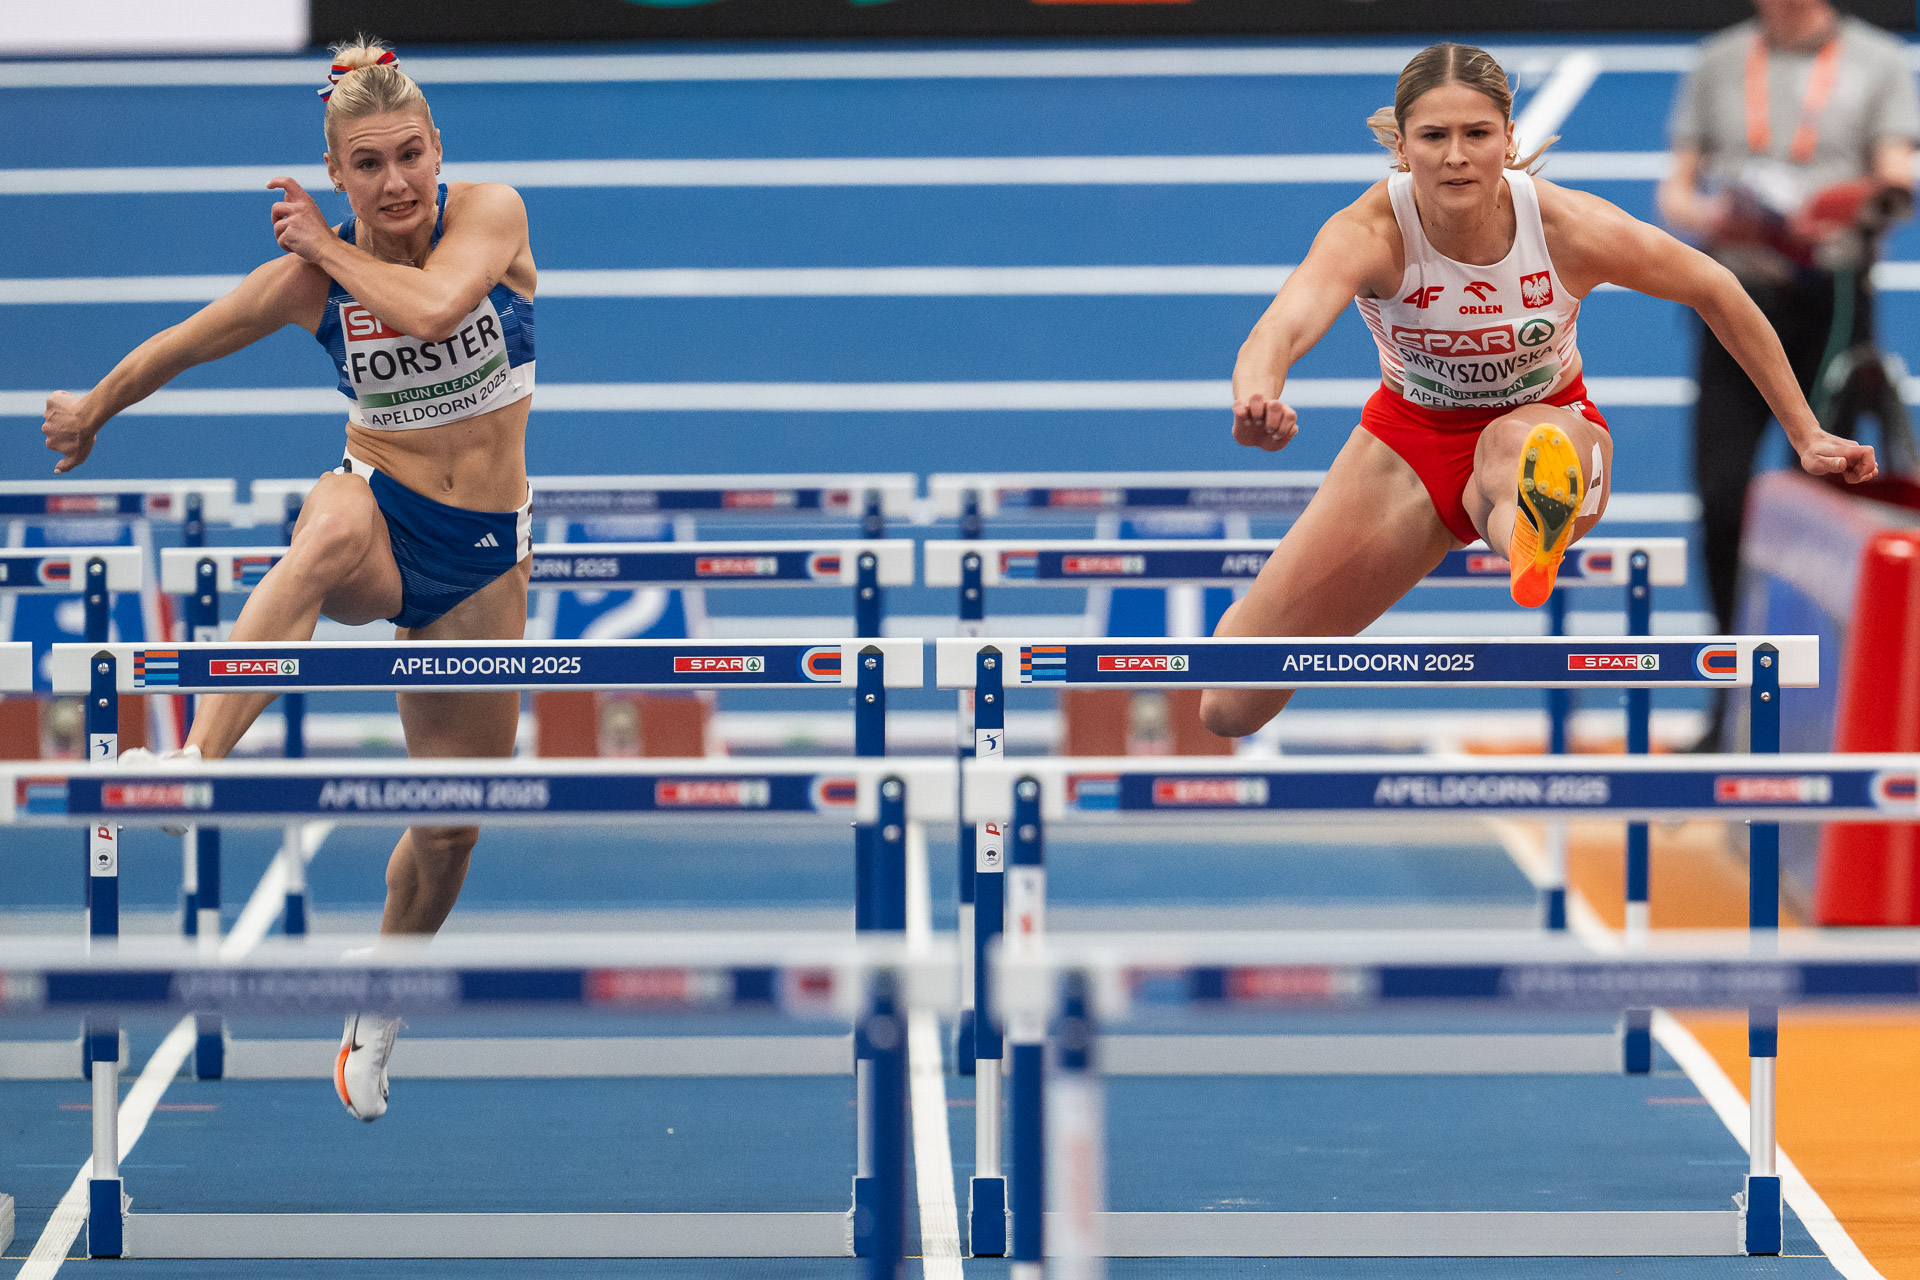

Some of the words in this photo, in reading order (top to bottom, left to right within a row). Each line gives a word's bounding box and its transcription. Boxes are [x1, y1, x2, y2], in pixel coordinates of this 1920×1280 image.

[1402, 286, 1445, 309] 4F
[1458, 304, 1503, 315] ORLEN
[351, 314, 500, 384] FORSTER
[1394, 330, 1513, 354] SPAR
[1399, 345, 1554, 384] SKRZYSZOWSKA
[372, 393, 478, 426] APELDOORN
[480, 369, 508, 401] 2025
[391, 394, 396, 404] I
[400, 386, 431, 402] RUN
[1442, 385, 1474, 399] RUN
[225, 662, 277, 673] SPAR
[391, 657, 526, 675] APELDOORN
[531, 656, 582, 674] 2025
[690, 658, 743, 670] SPAR
[1113, 657, 1167, 669] SPAR
[1282, 654, 1419, 672] APELDOORN
[1424, 654, 1475, 671] 2025
[1584, 656, 1637, 668] SPAR
